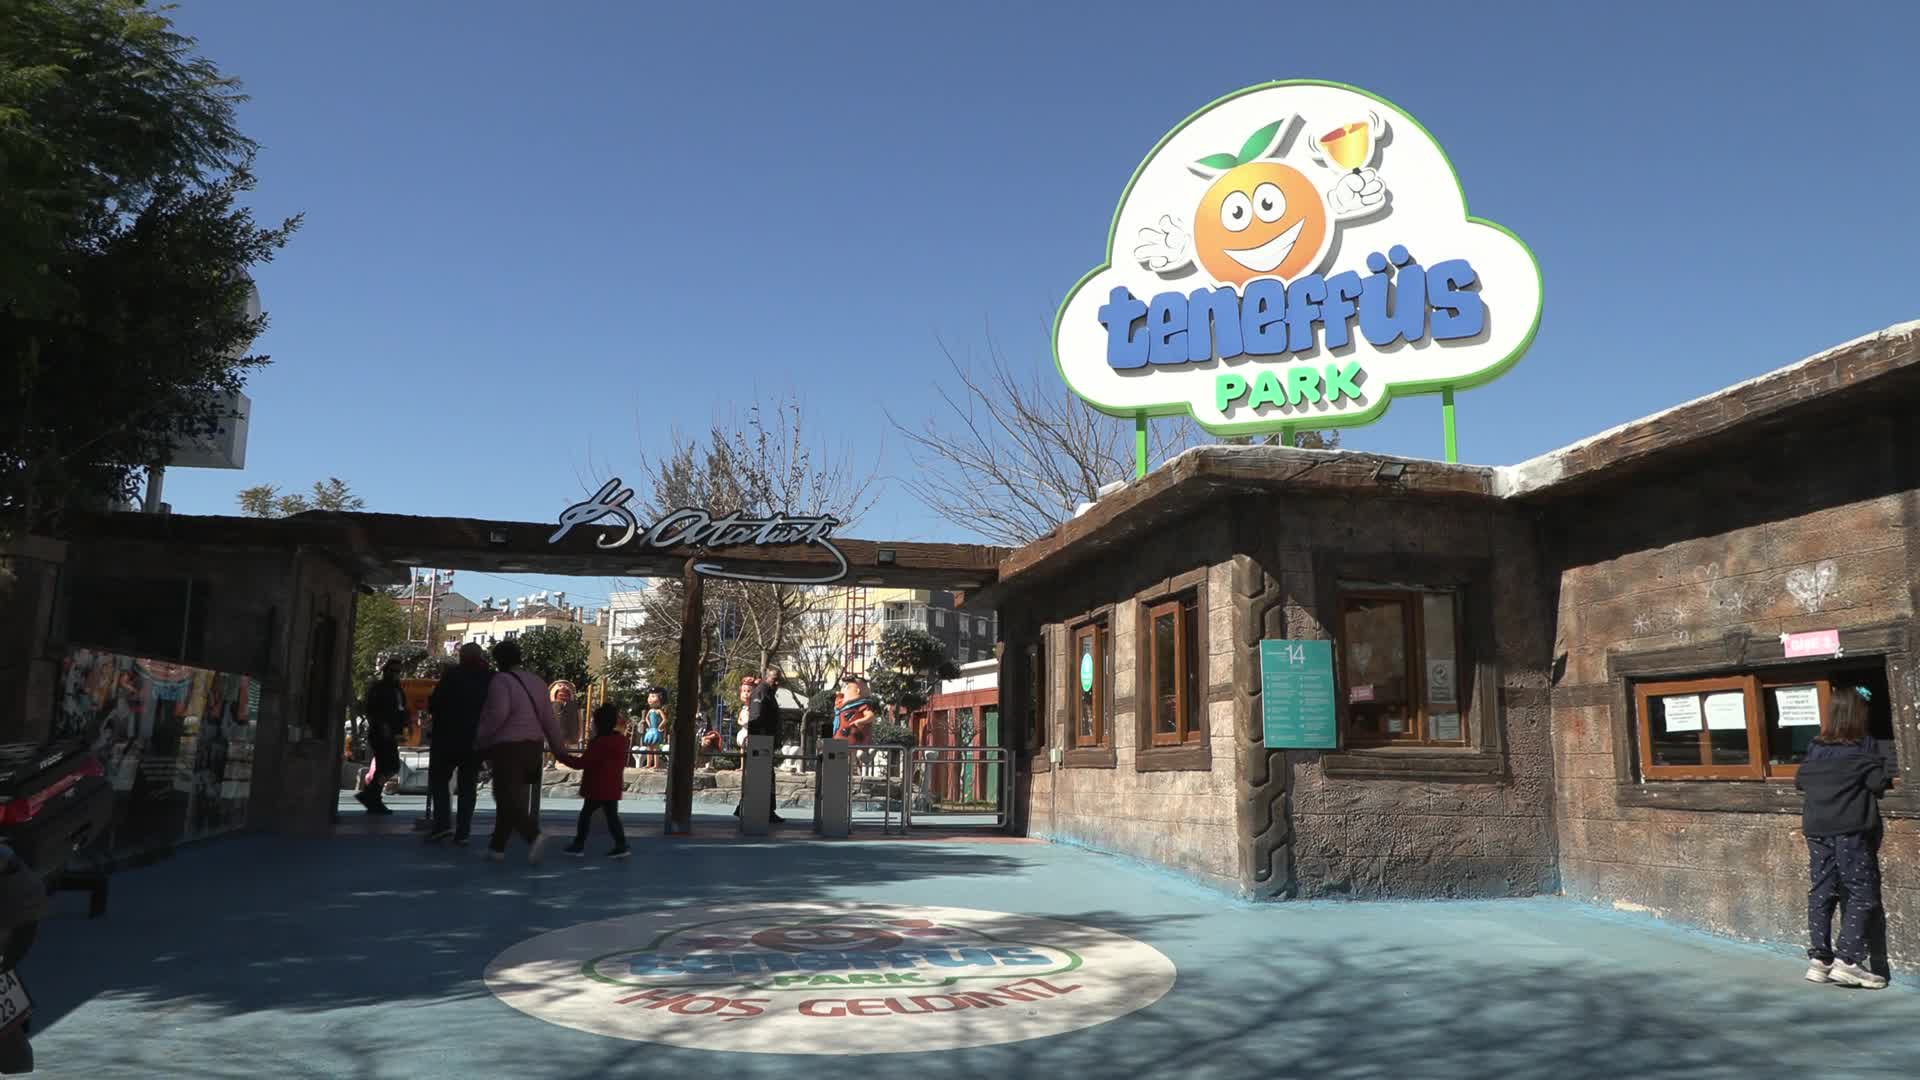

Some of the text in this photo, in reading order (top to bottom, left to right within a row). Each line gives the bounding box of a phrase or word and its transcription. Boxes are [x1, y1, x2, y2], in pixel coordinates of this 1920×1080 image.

[1098, 245, 1483, 369] teneffüs
[1215, 361, 1362, 412] PARK
[1285, 644, 1306, 665] 14
[773, 971, 922, 988] PARK
[614, 988, 771, 1022] HOŞ
